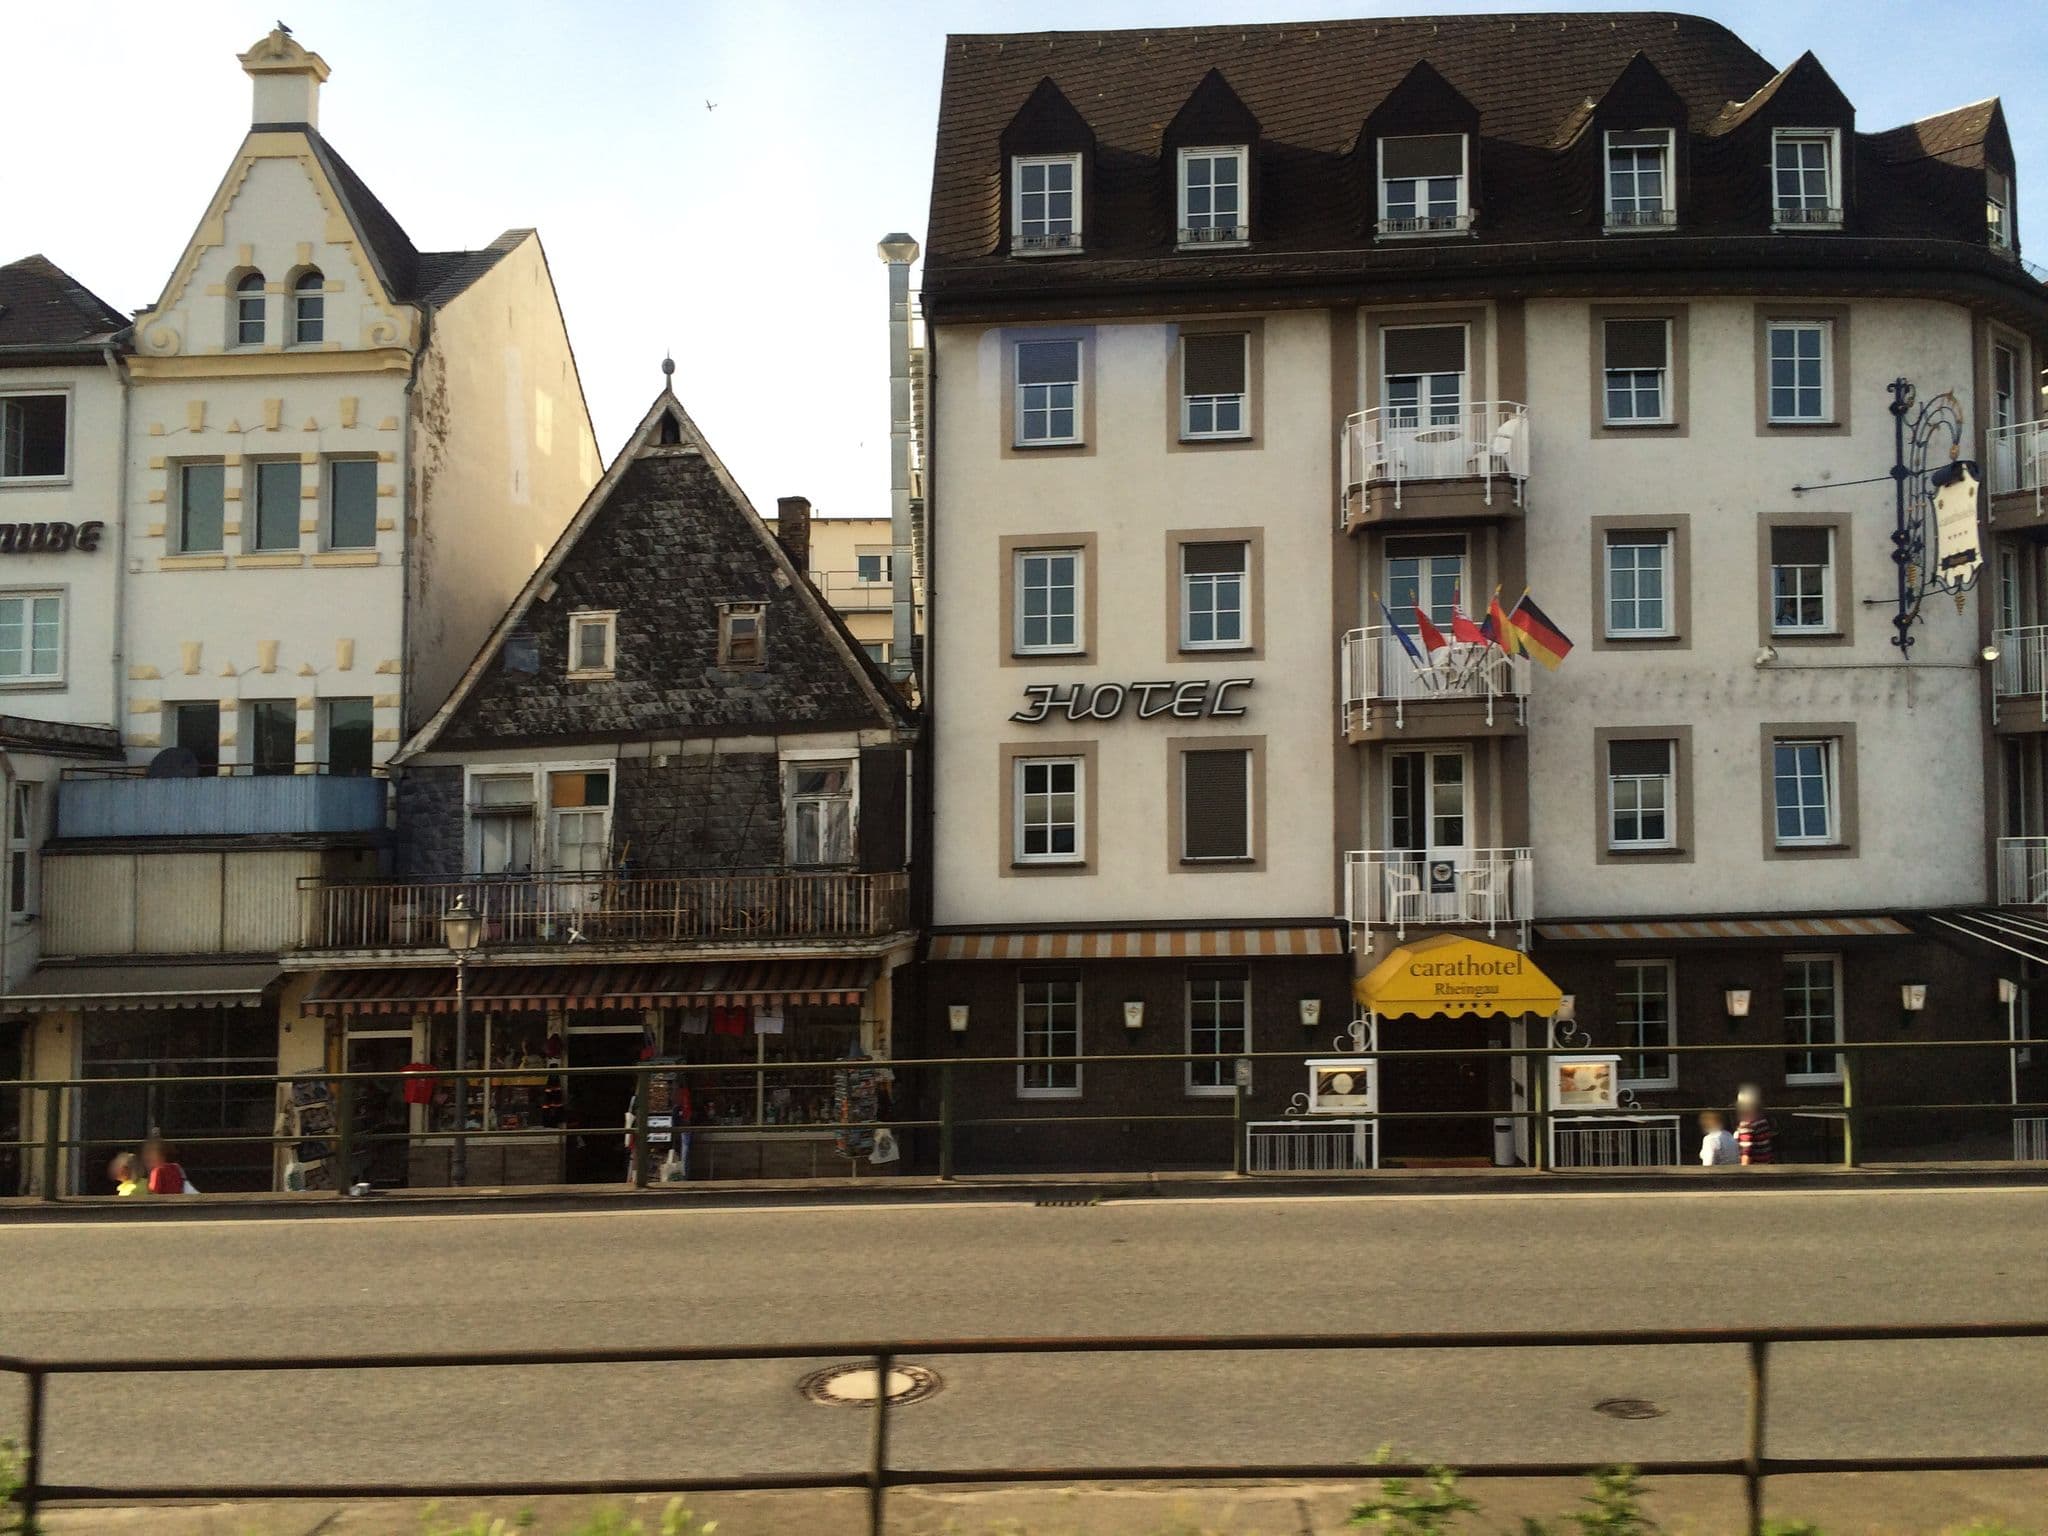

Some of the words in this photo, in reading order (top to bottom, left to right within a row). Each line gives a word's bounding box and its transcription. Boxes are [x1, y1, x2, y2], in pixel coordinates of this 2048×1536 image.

[1008, 677, 1255, 725] HOTEL
[1409, 954, 1523, 977] carathotel
[1434, 982, 1500, 997] Rheingau
